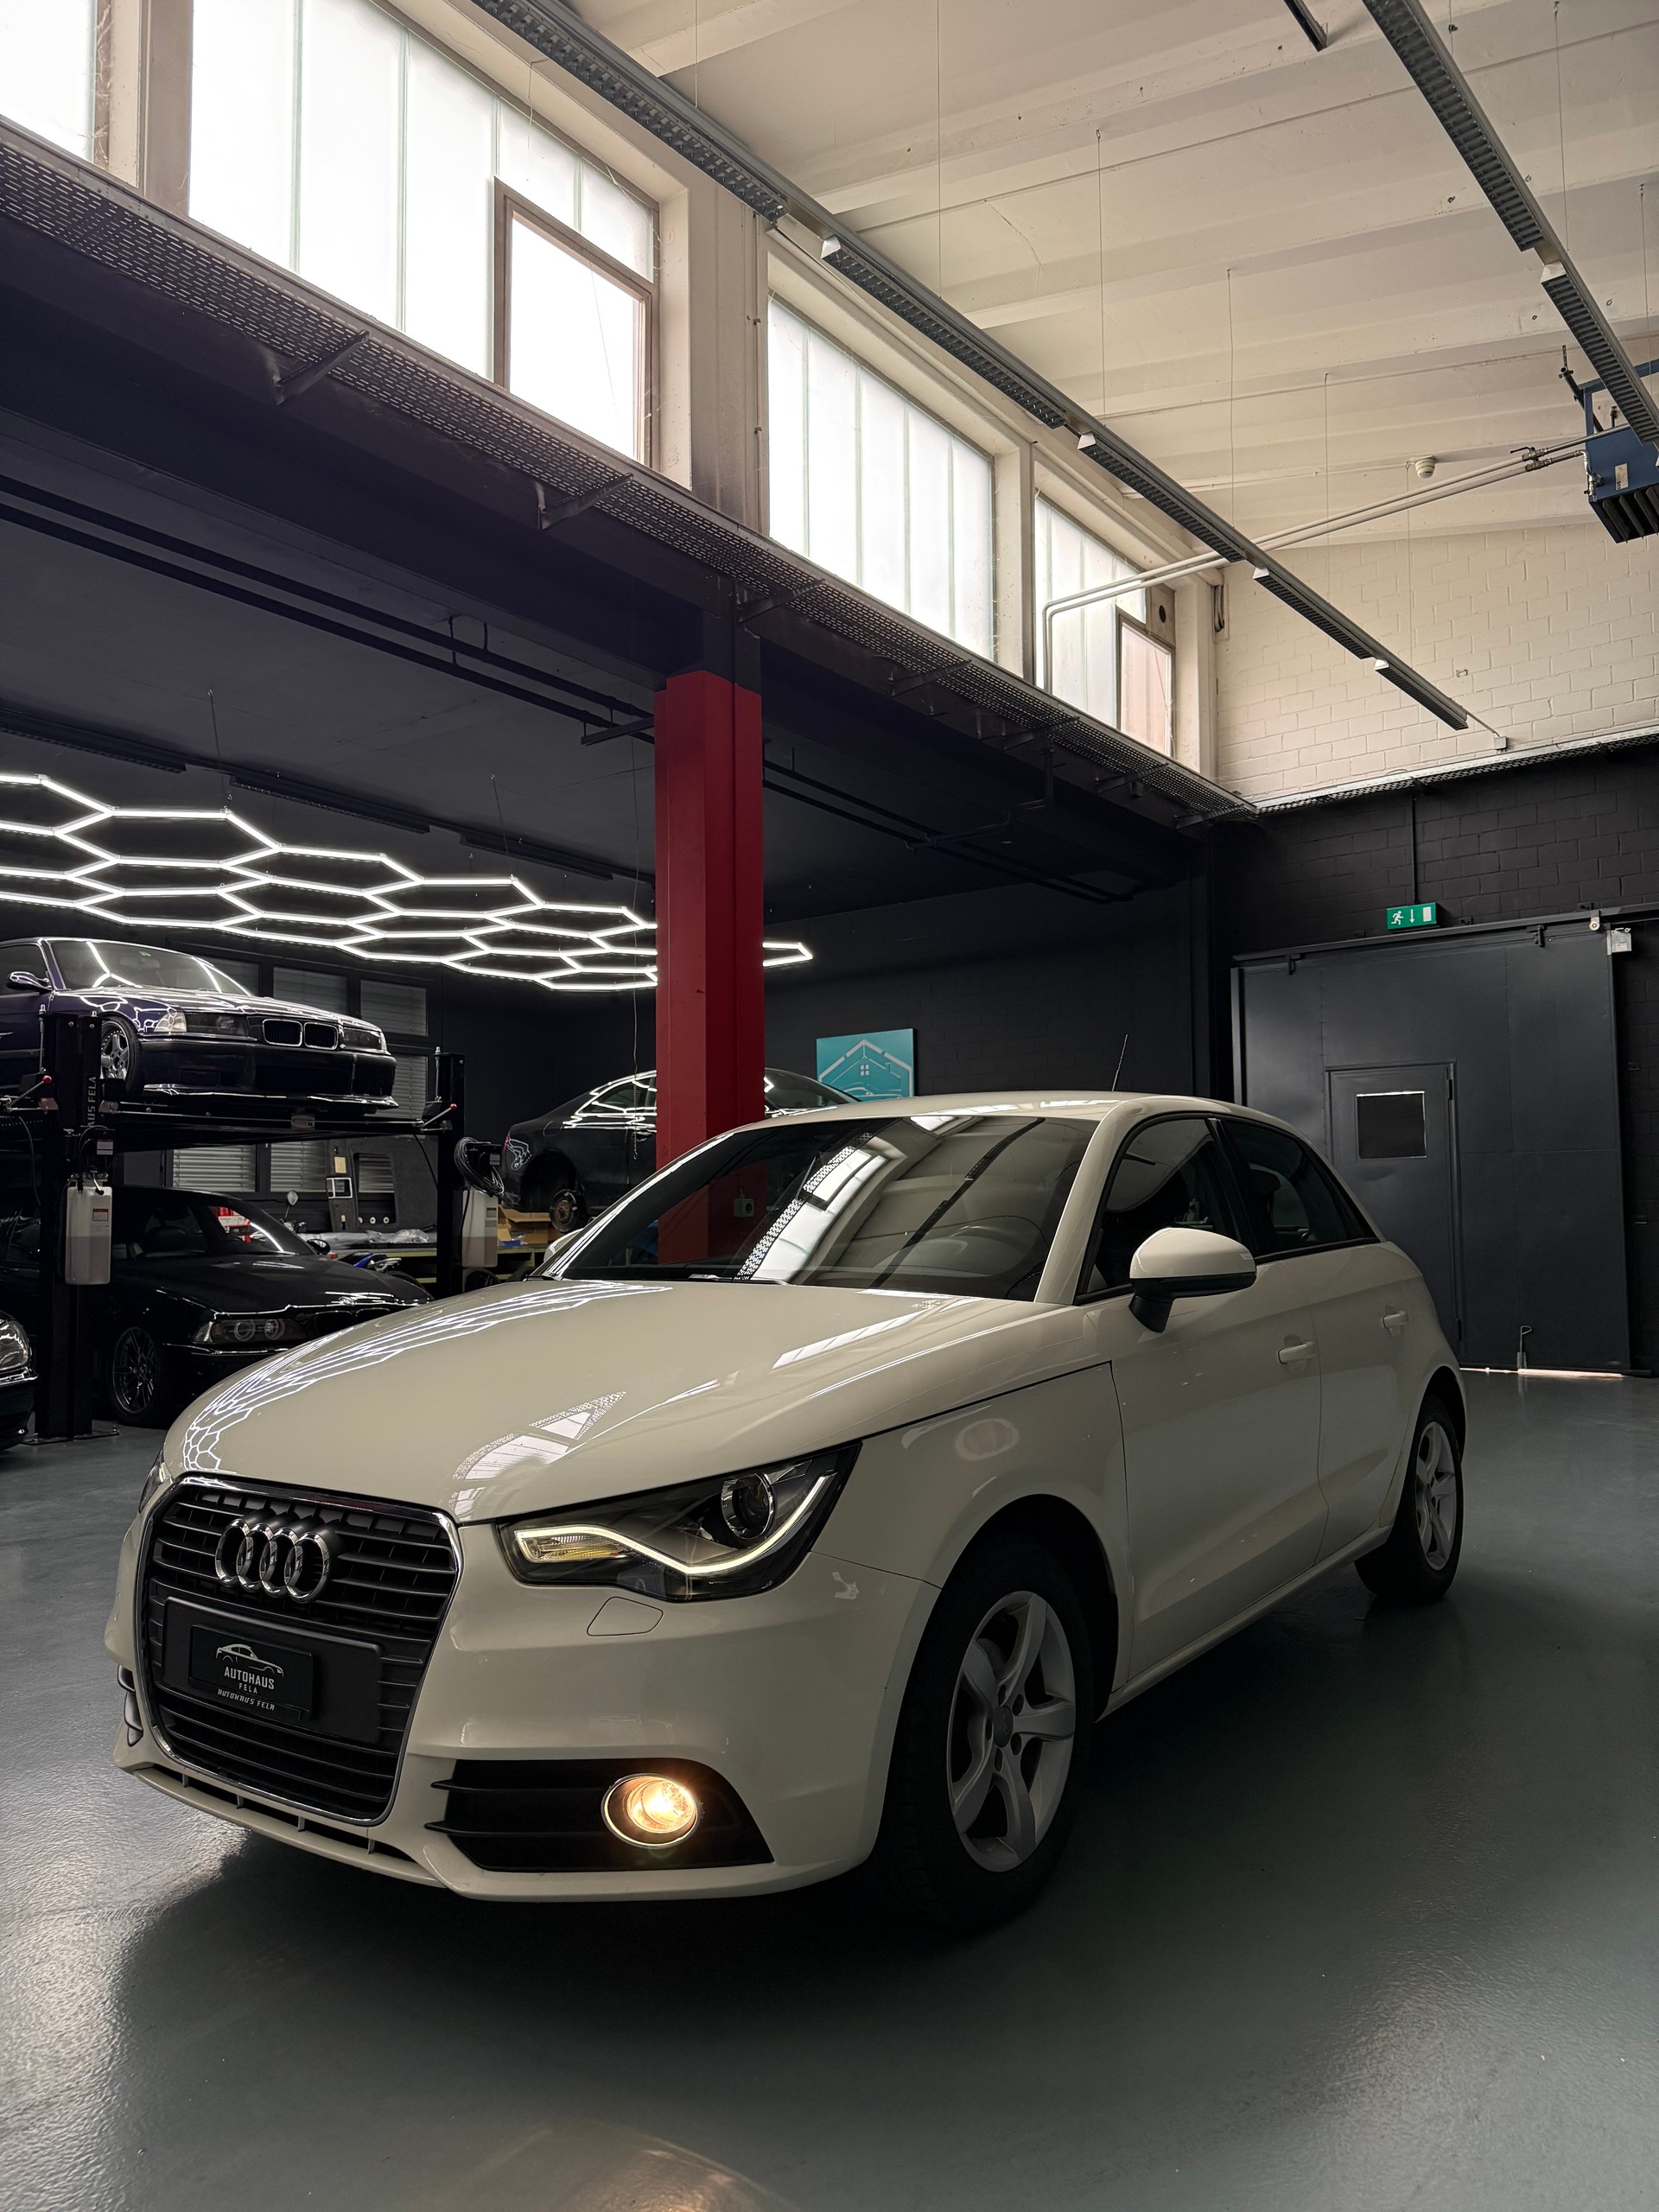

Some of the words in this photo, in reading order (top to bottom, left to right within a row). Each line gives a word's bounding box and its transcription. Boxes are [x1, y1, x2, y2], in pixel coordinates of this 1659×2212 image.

[88, 1077, 97, 1103] FELA
[225, 1666, 275, 1690] AUTOHAUS
[238, 1682, 257, 1694] FELA
[217, 1688, 256, 1705] AUTOHAUS
[257, 1700, 276, 1711] FELA
